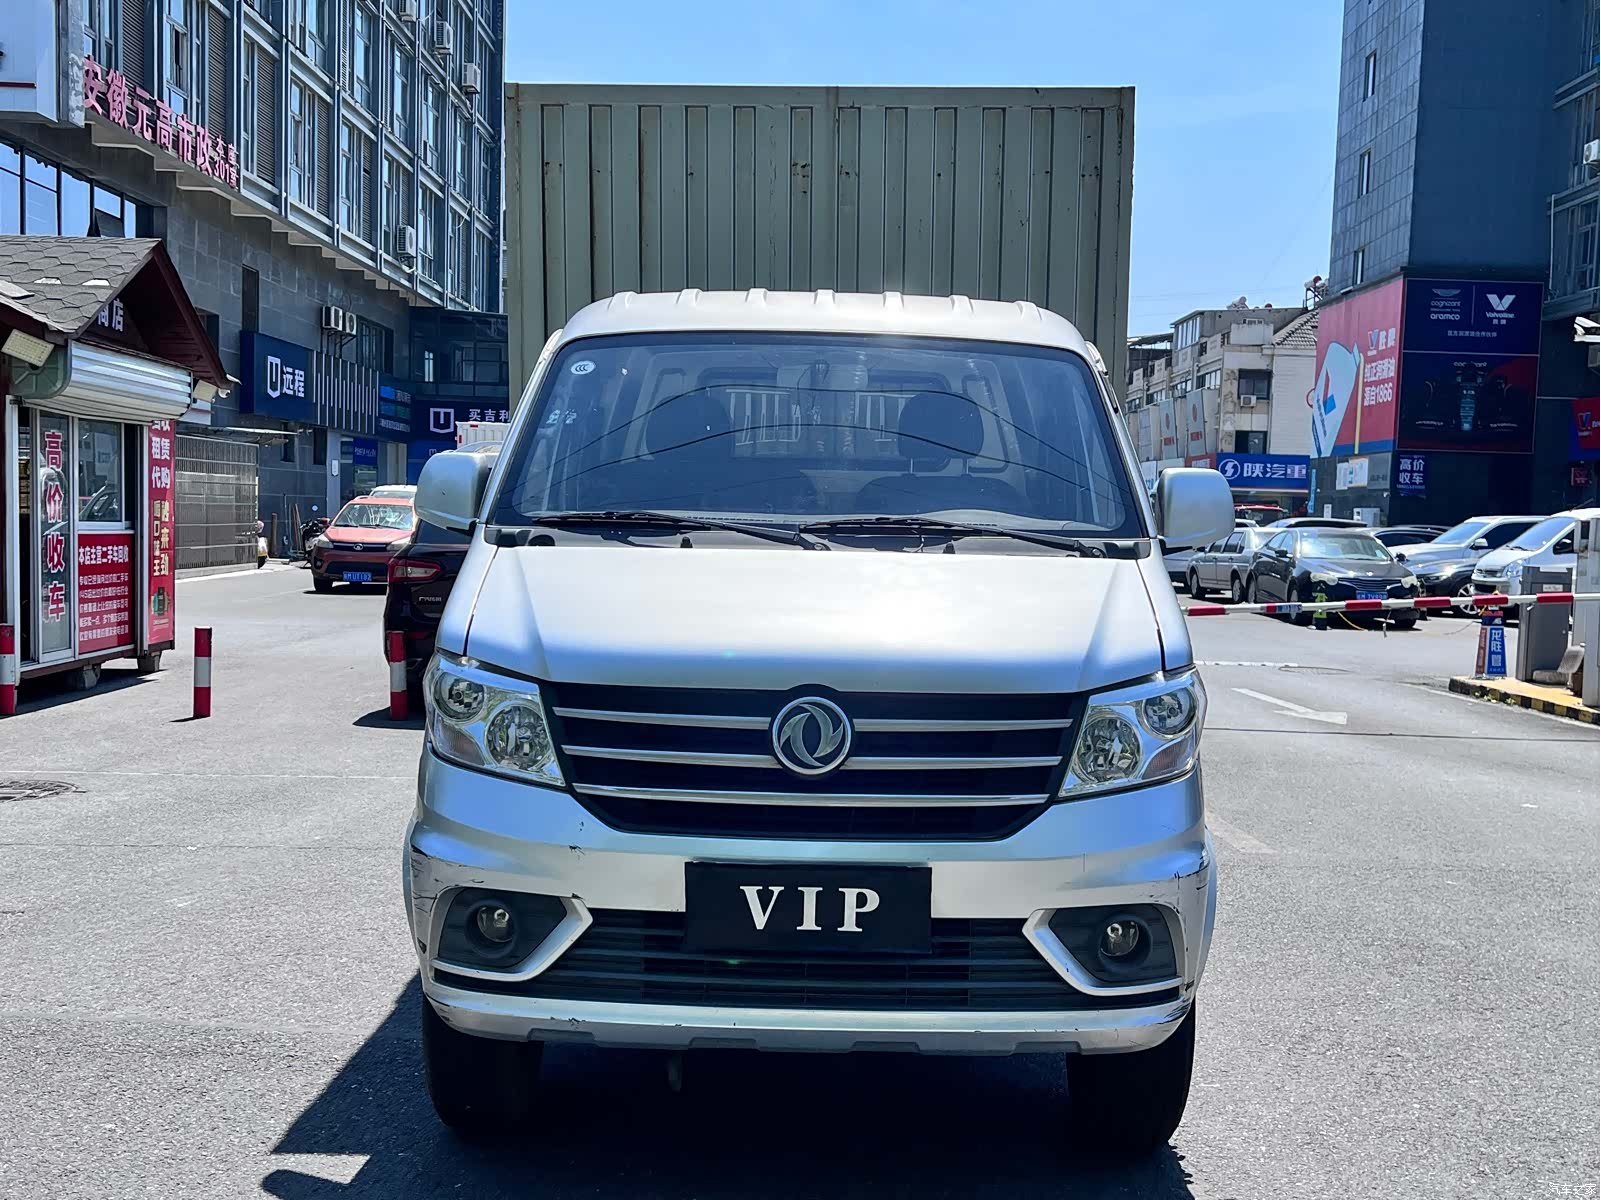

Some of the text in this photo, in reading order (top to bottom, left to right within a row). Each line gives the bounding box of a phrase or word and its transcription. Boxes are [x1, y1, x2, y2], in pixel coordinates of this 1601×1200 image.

[84, 55, 211, 178] 安徽元高市政
[1430, 313, 1460, 321] aramco
[282, 368, 305, 398] 远程
[468, 408, 511, 422] 买吉利
[151, 436, 170, 460] 租赁
[1399, 458, 1425, 471] 高价
[151, 466, 171, 489] 代购
[1399, 472, 1424, 485] 收车
[44, 429, 66, 622] 高价收车
[79, 545, 129, 565] 本店主营二手车回收
[739, 885, 881, 932] VIP
